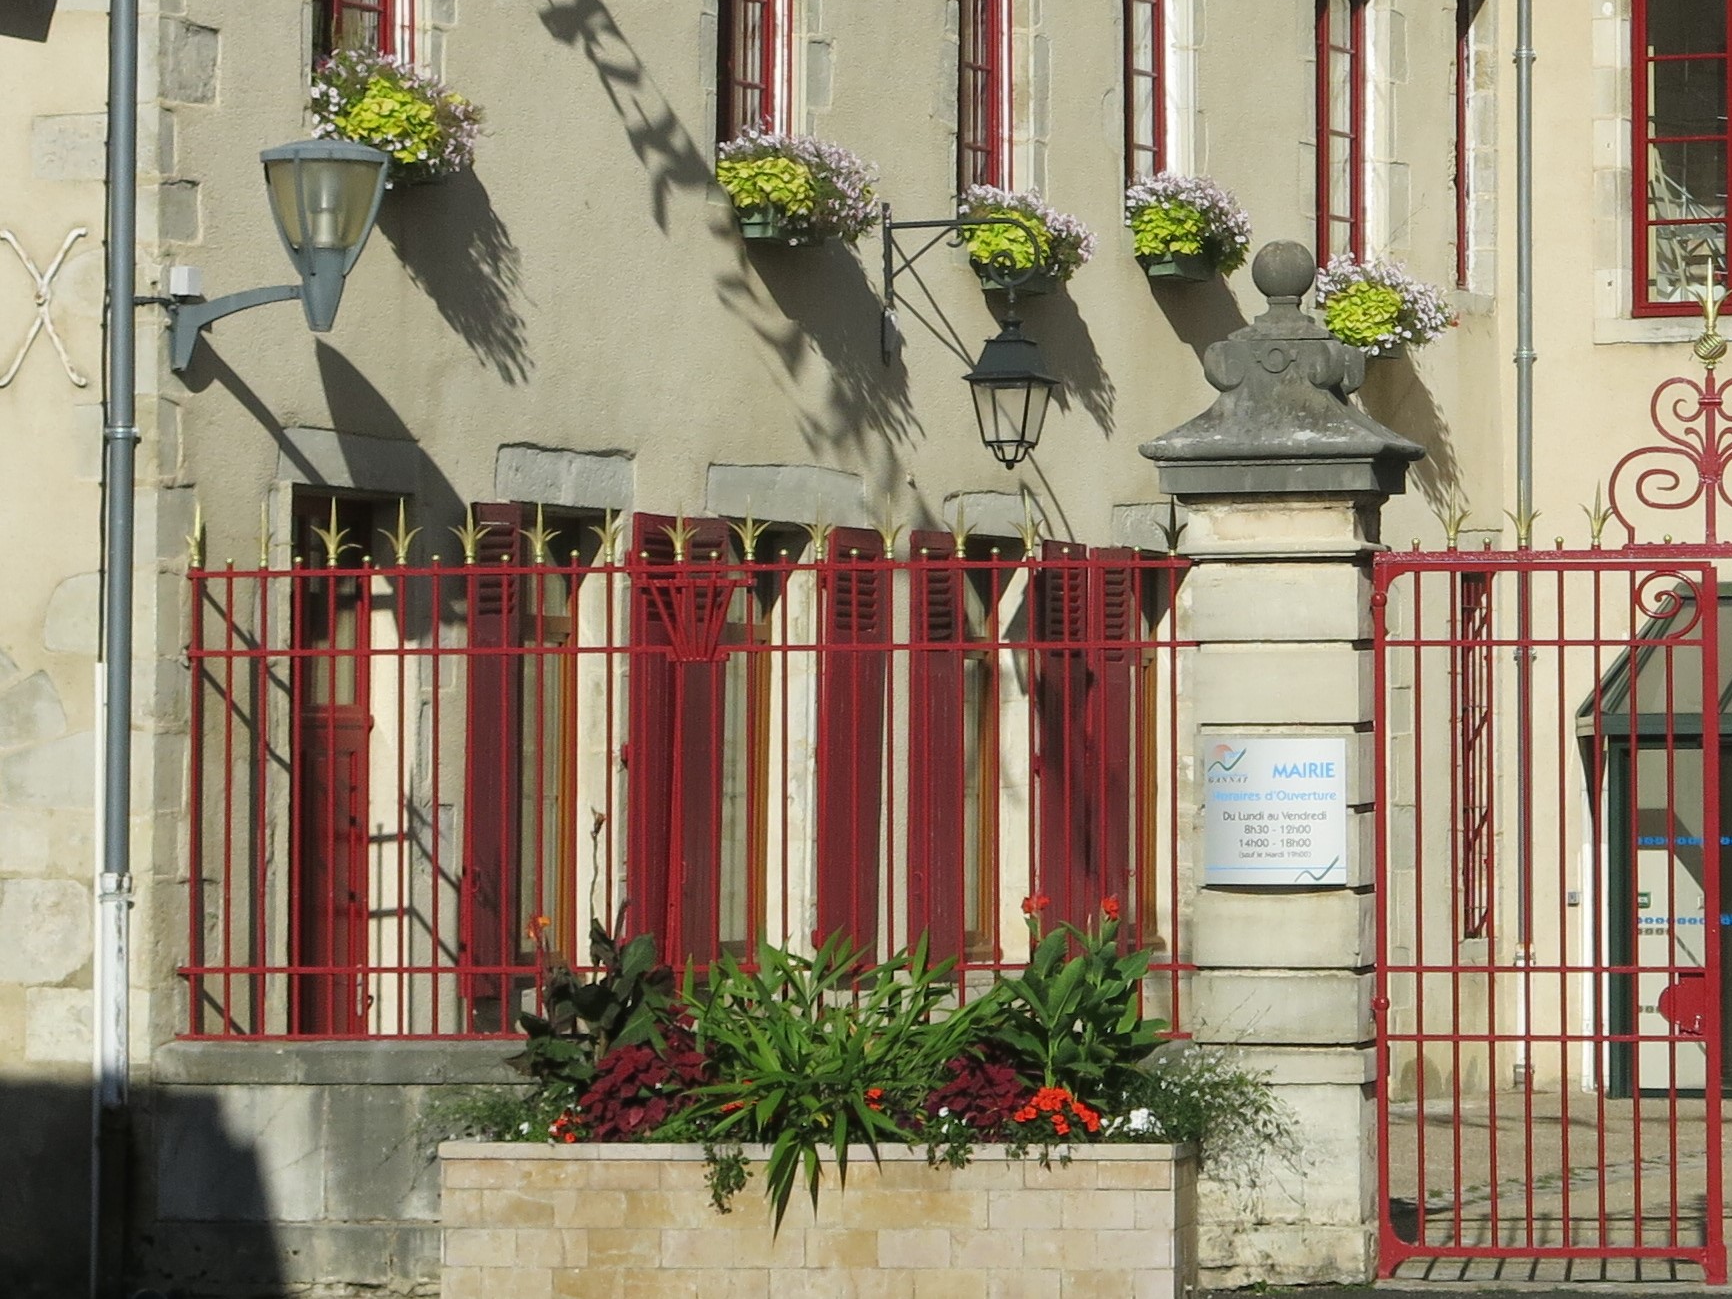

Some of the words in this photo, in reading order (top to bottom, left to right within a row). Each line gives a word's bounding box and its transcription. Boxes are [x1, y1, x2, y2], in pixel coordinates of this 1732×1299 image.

[1272, 762, 1336, 779] MAIRIE
[1264, 789, 1337, 801] d'Ouverture
[1223, 811, 1236, 821] Du
[1238, 811, 1265, 821] Lundi
[1266, 813, 1279, 821] au
[1281, 811, 1327, 821] Vendredi
[1243, 824, 1270, 834] 8h30
[1280, 824, 1312, 834] 12h00
[1239, 838, 1270, 848] 14h00
[1280, 838, 1312, 848] 18h00
